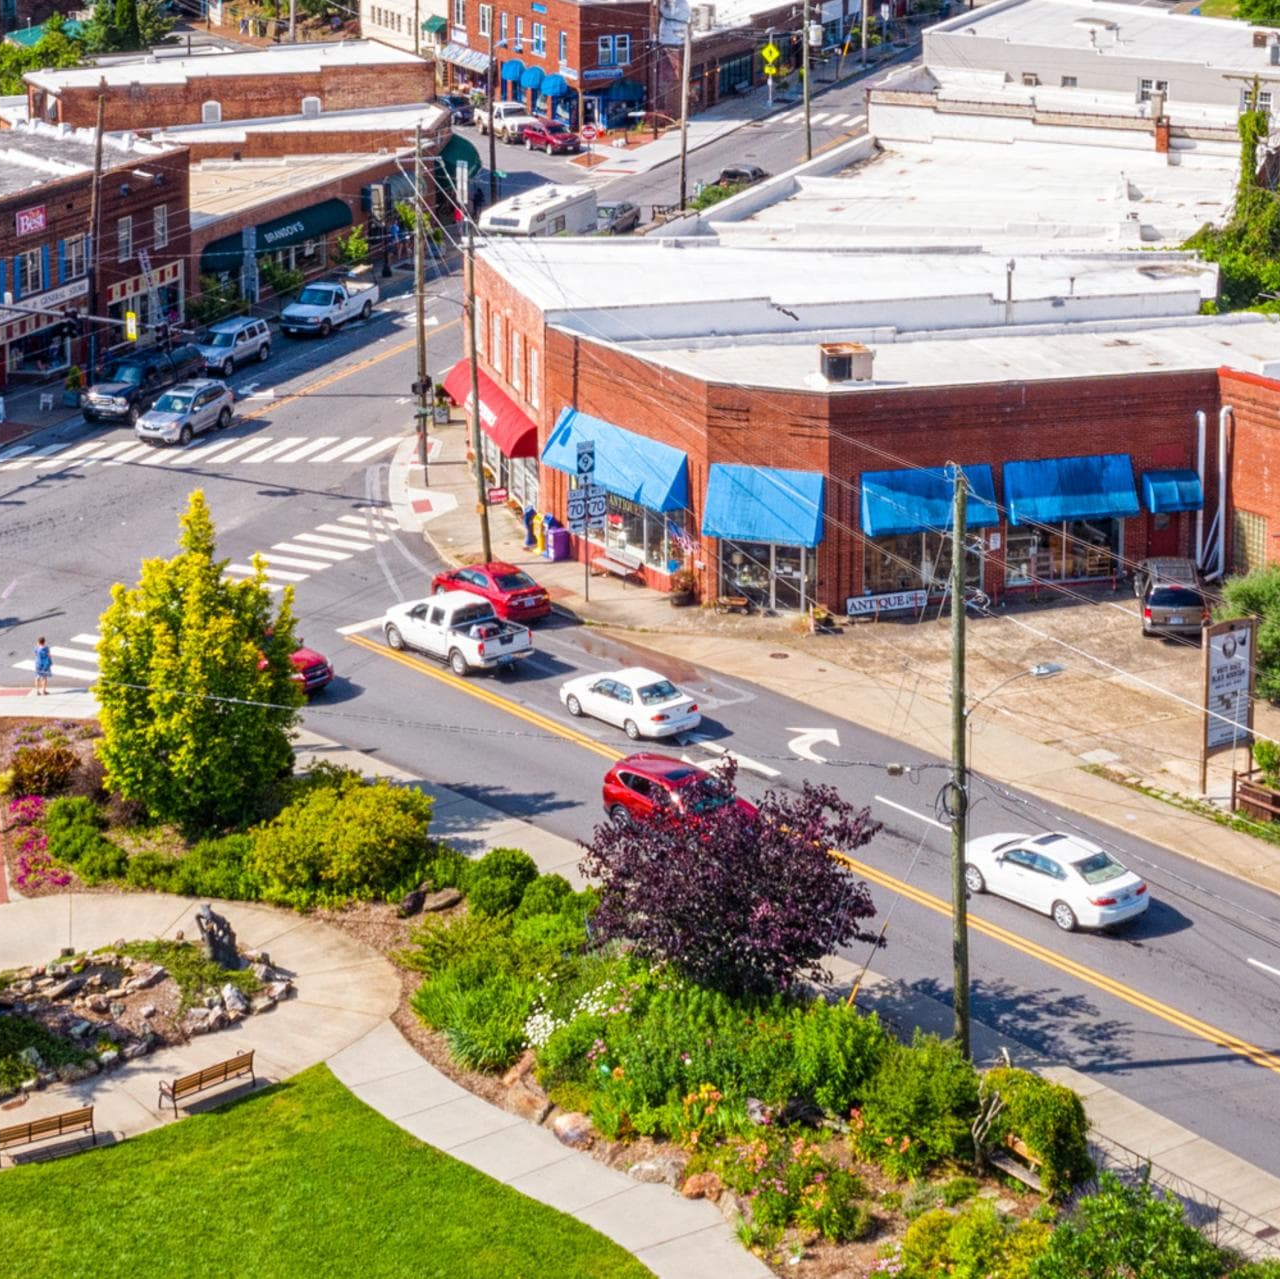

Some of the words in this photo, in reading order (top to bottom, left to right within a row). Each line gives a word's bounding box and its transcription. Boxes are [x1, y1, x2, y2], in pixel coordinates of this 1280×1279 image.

[264, 221, 304, 243] BRANDON'S
[582, 457, 589, 468] 9
[570, 503, 583, 515] 70
[592, 500, 604, 512] 70
